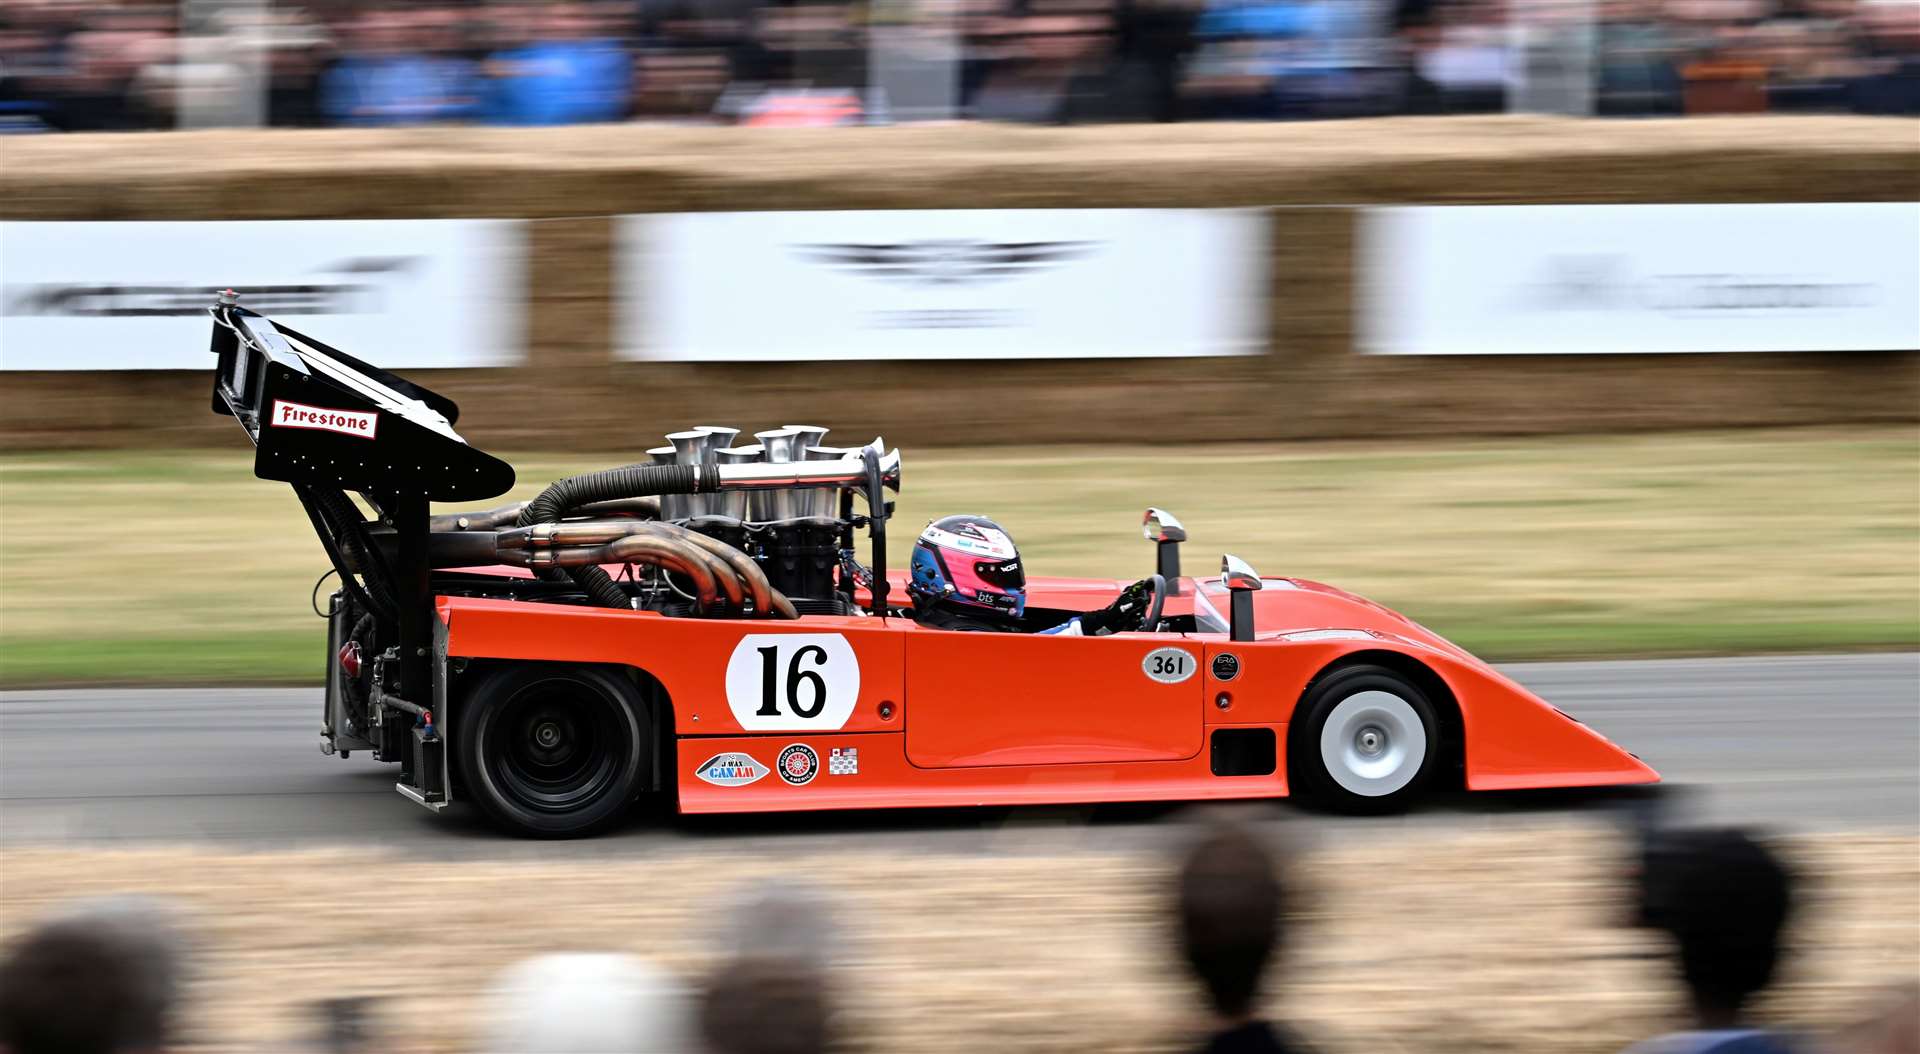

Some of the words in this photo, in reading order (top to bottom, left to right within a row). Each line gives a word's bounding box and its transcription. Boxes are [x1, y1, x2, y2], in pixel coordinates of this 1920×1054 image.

[282, 405, 368, 430] Firestone
[978, 591, 994, 603] bts
[1153, 656, 1183, 674] 361
[756, 645, 828, 718] 16
[780, 747, 795, 767] SPORTS
[807, 751, 816, 767] CLUB
[789, 772, 813, 782] AMERICA
